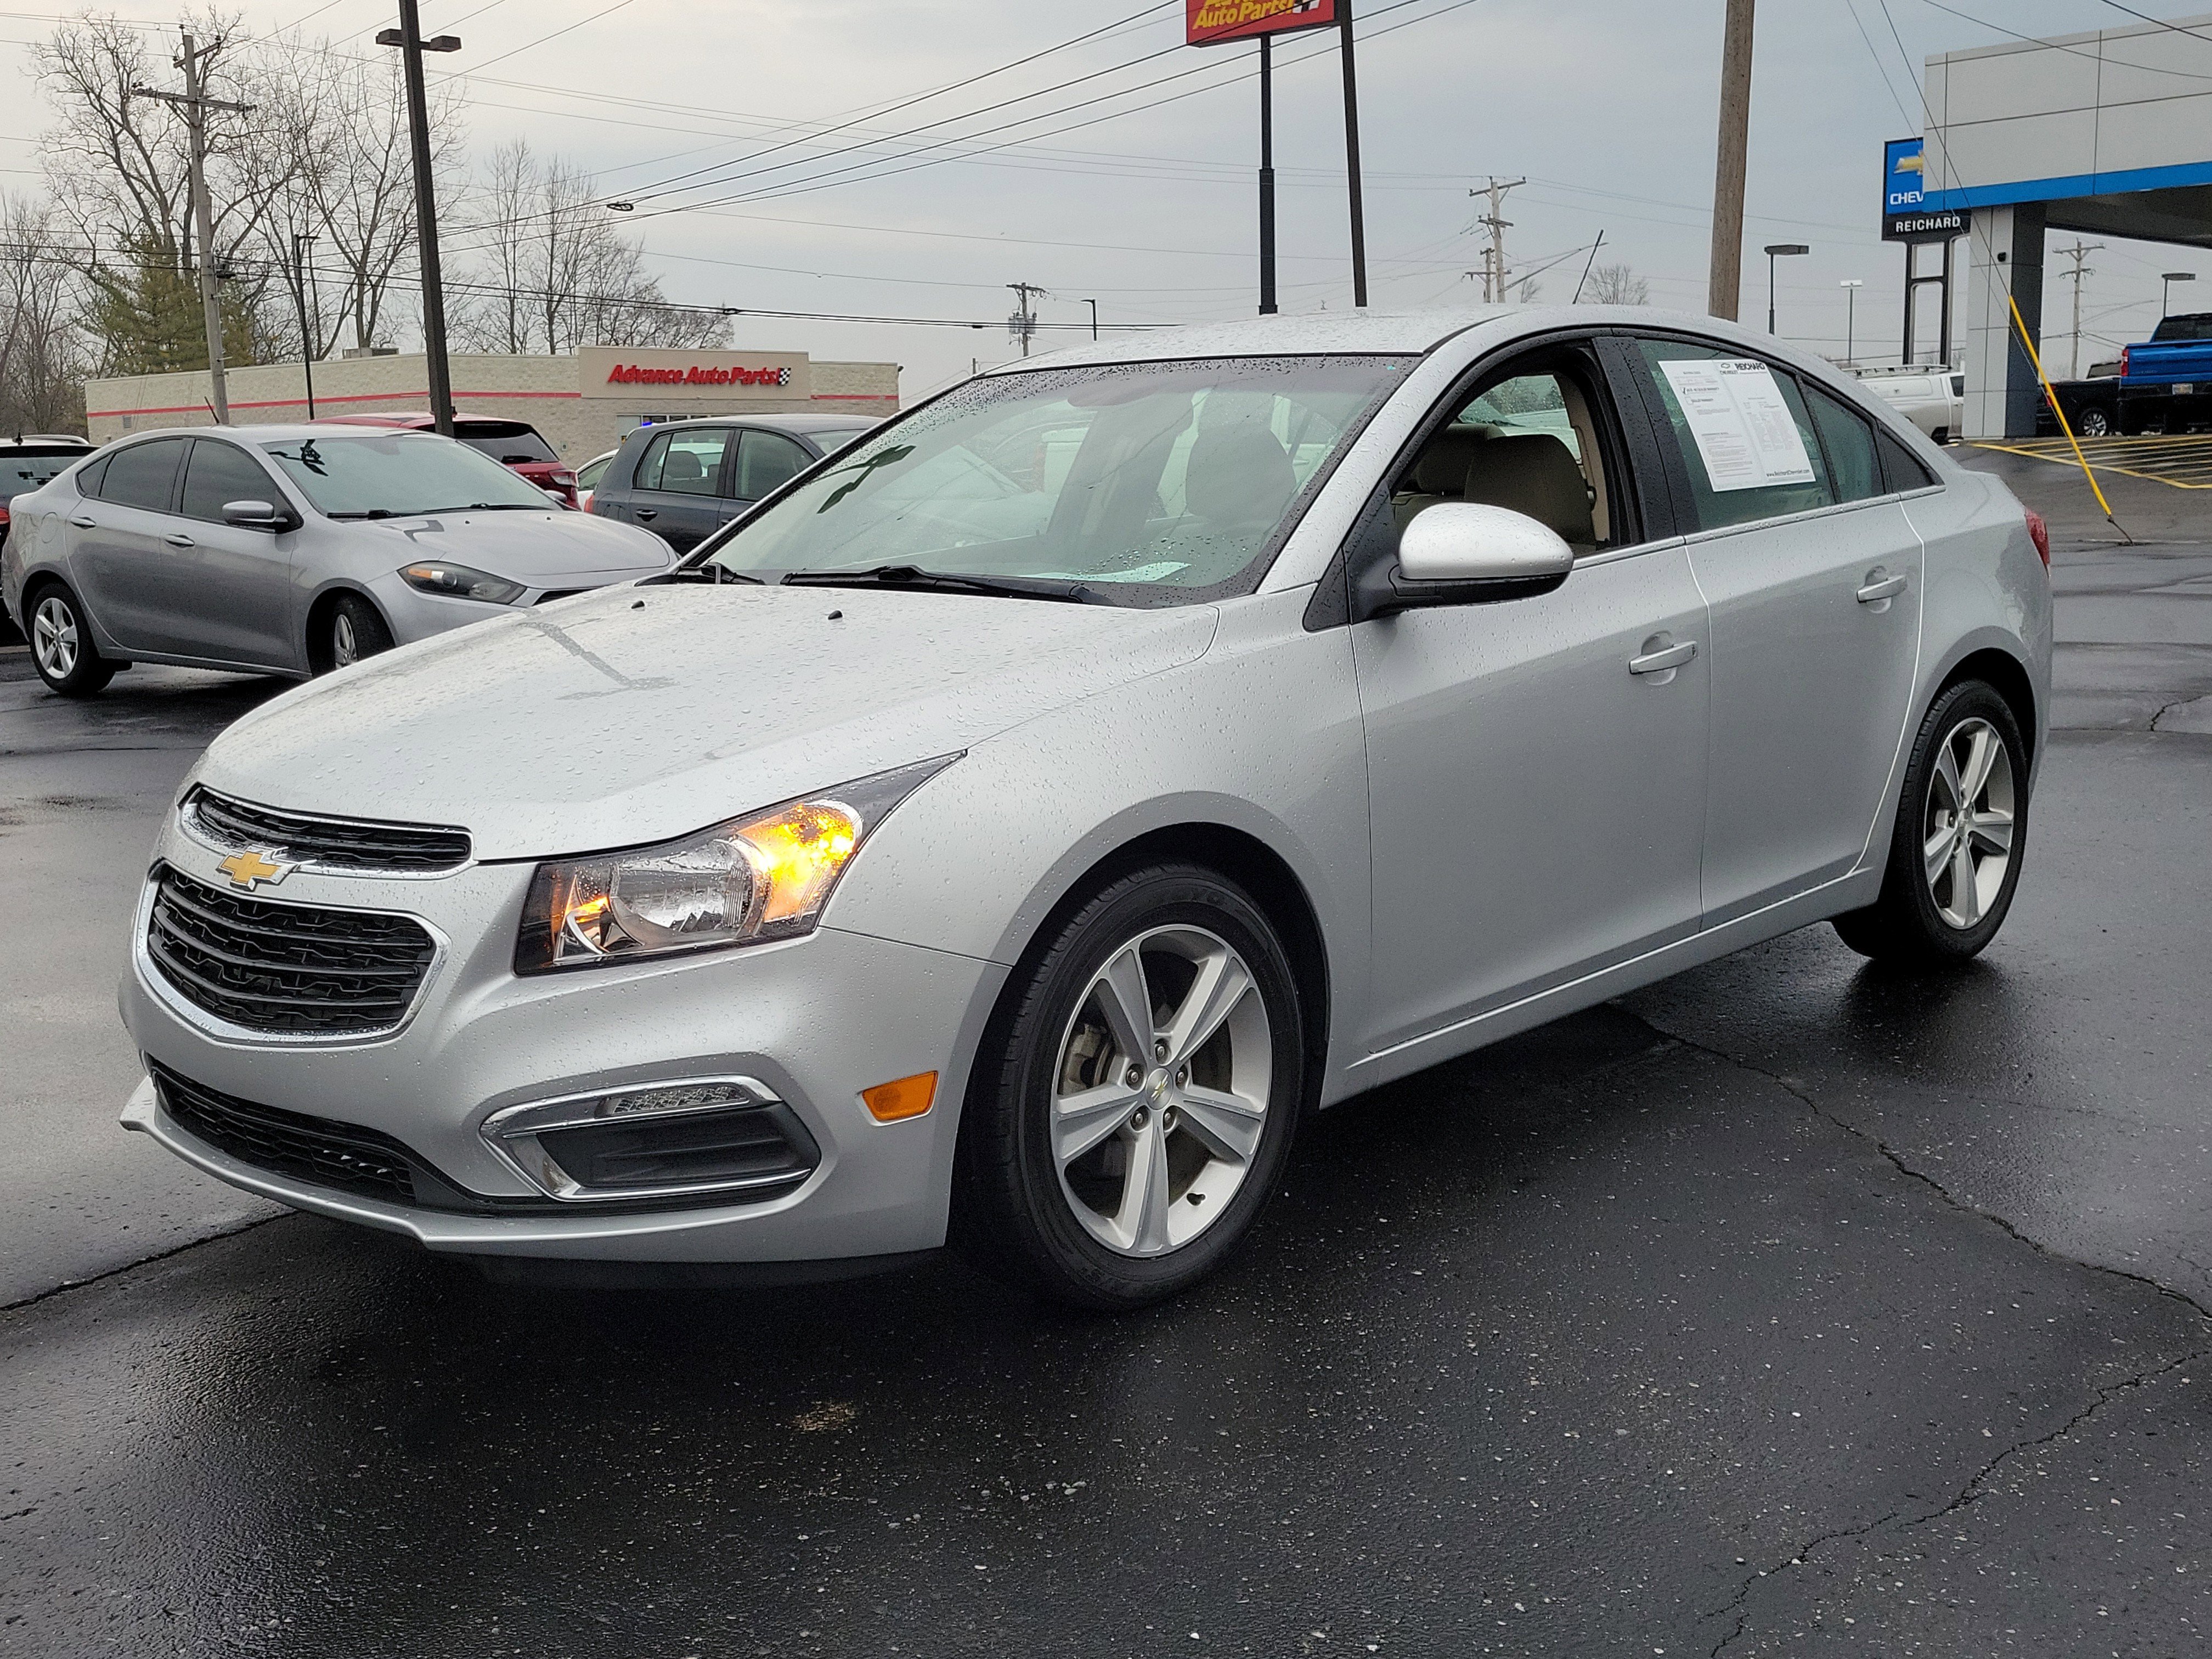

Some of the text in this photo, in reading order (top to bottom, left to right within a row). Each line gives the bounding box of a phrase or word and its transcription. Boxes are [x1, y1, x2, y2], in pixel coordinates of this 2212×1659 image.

[1192, 7, 1238, 30] Auto
[1895, 216, 1961, 233] REICHARD
[608, 364, 684, 384] Advance
[685, 366, 729, 385] Auto
